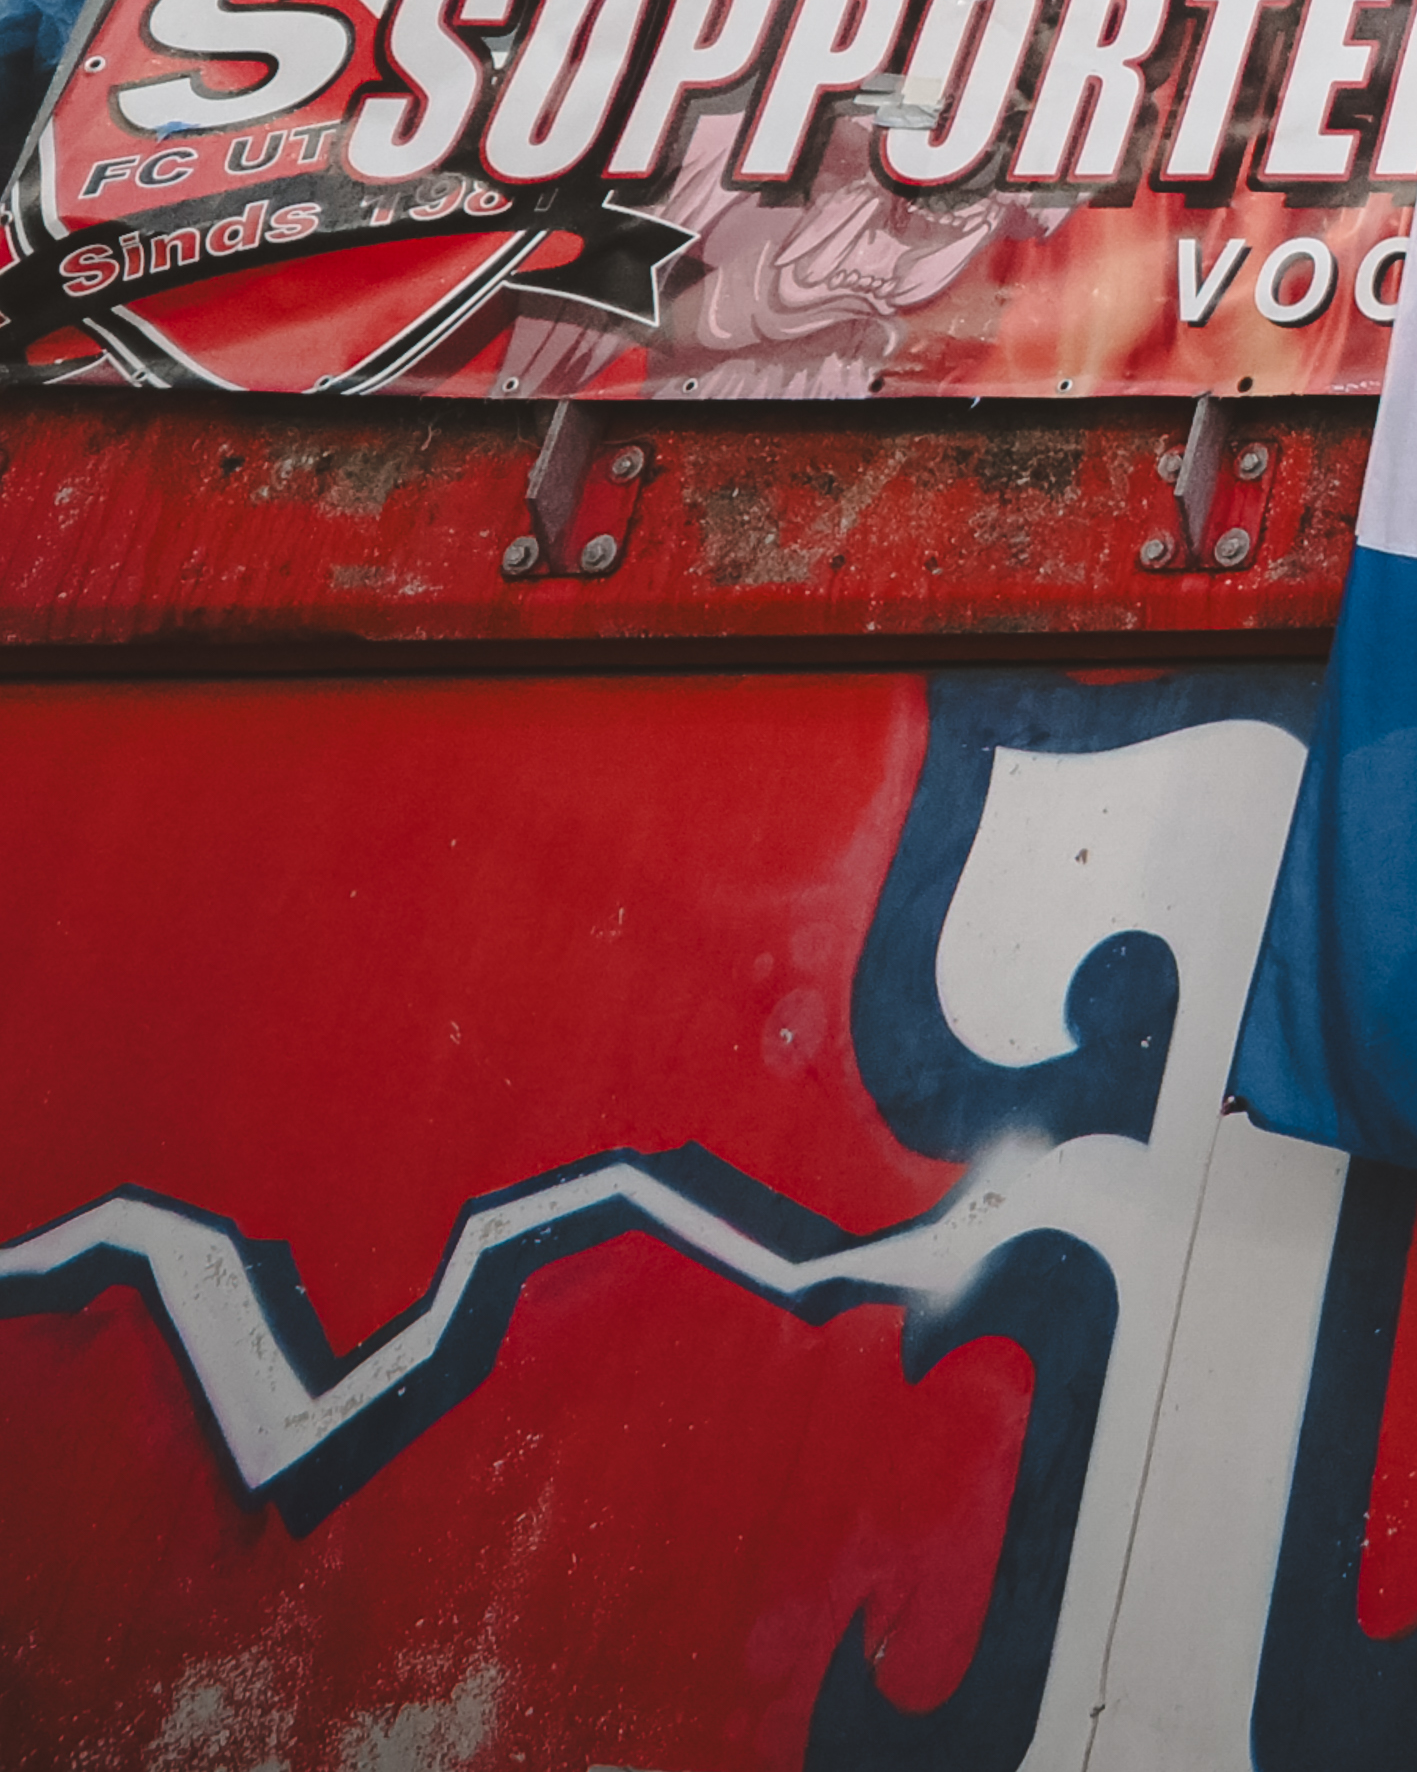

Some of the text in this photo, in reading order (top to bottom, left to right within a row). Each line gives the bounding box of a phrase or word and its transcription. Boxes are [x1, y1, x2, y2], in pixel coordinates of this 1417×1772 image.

[78, 147, 198, 199] FC
[60, 170, 561, 298] Sinds 198
